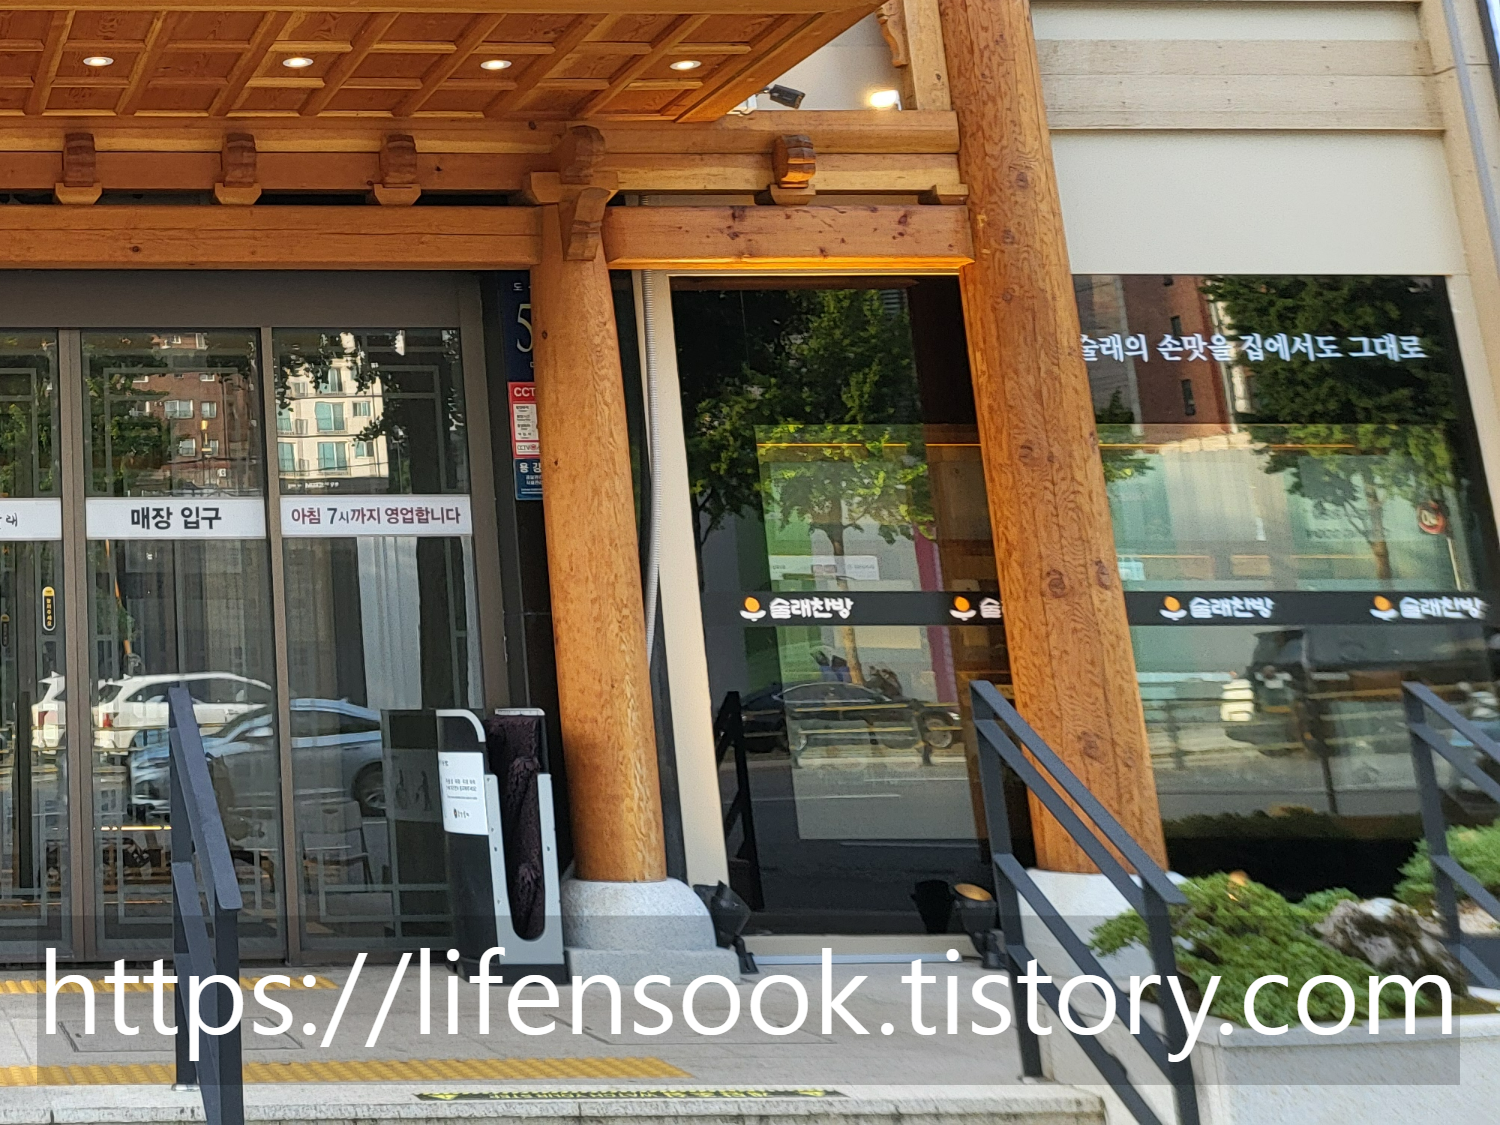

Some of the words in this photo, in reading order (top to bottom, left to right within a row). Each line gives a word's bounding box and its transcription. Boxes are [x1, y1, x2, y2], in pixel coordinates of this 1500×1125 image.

[1157, 332, 1234, 363] 손맛을
[1240, 332, 1344, 363] 집에서도
[1348, 333, 1430, 361] 그대로
[131, 507, 173, 531] 매장
[180, 507, 223, 531] 입구
[291, 507, 321, 525] 아침
[326, 506, 381, 525] 7시까지
[384, 506, 461, 525] 영업합니다
[769, 597, 854, 619] 술래찬방
[1189, 596, 1274, 619] 술래찬방
